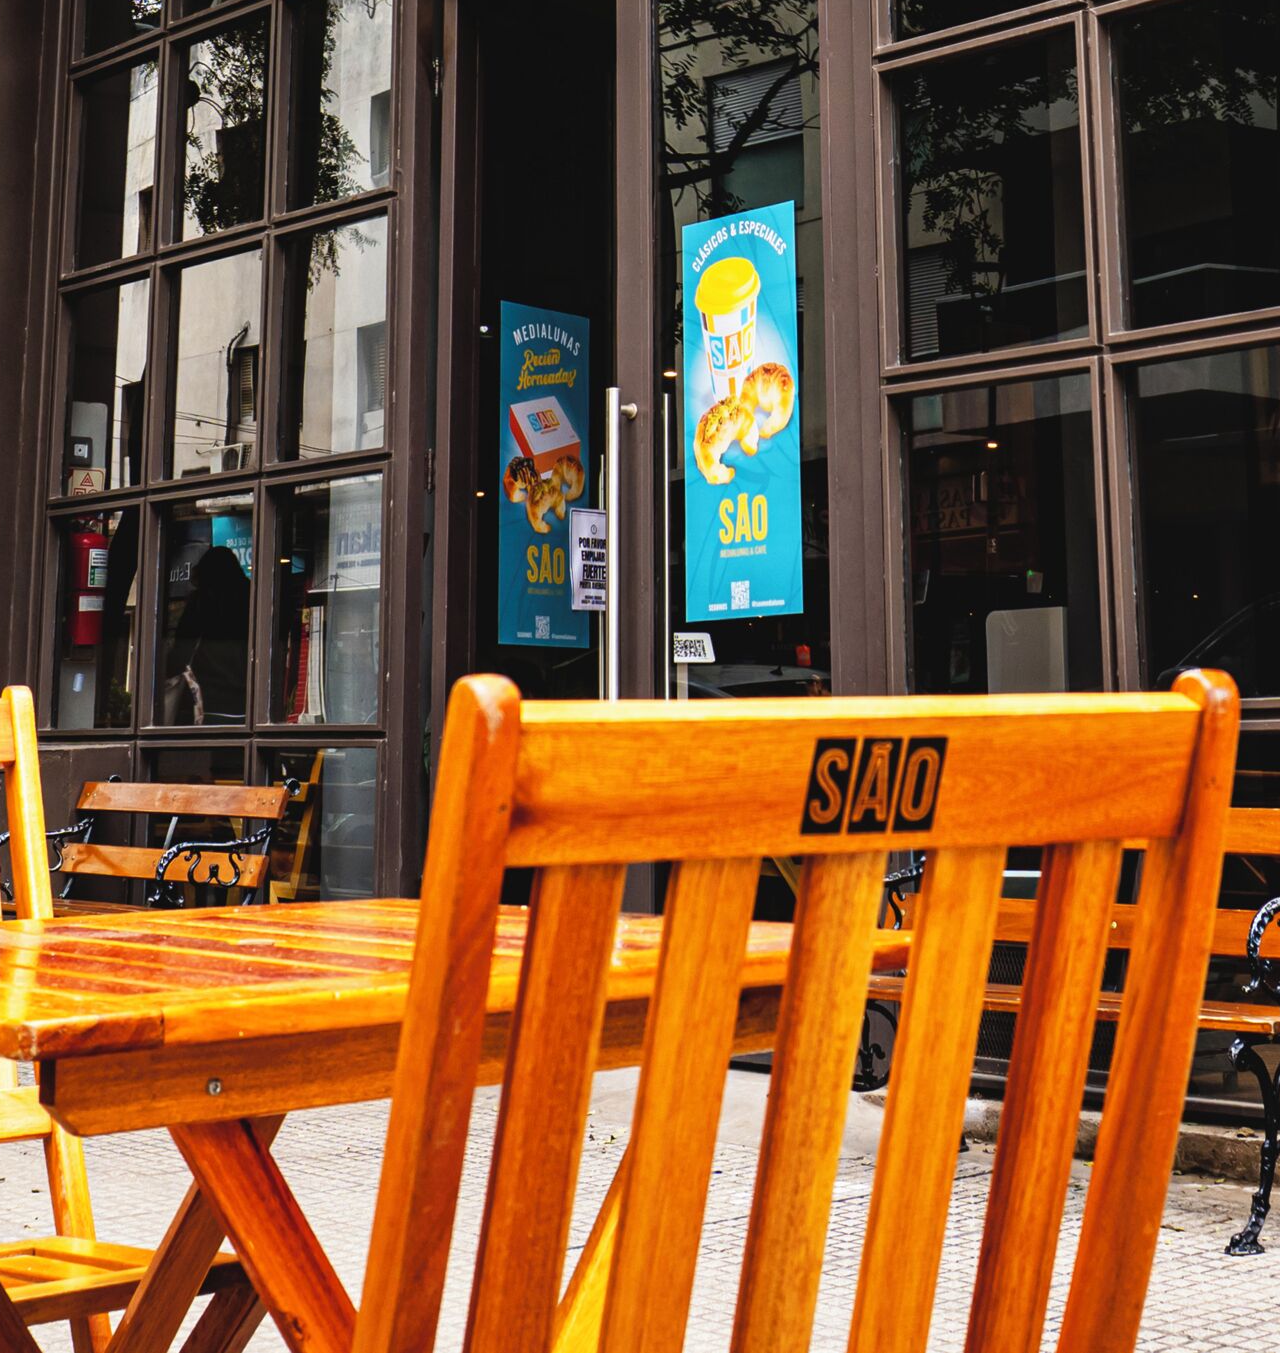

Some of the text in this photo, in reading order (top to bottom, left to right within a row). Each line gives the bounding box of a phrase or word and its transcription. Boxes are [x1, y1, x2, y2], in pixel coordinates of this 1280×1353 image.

[691, 220, 787, 273] CLÁSICOS & ESPECIALES
[513, 323, 581, 356] MEDIALUNAS
[578, 537, 590, 548] POR
[581, 550, 605, 562] EMPUJAR
[582, 564, 606, 579] FUERTE
